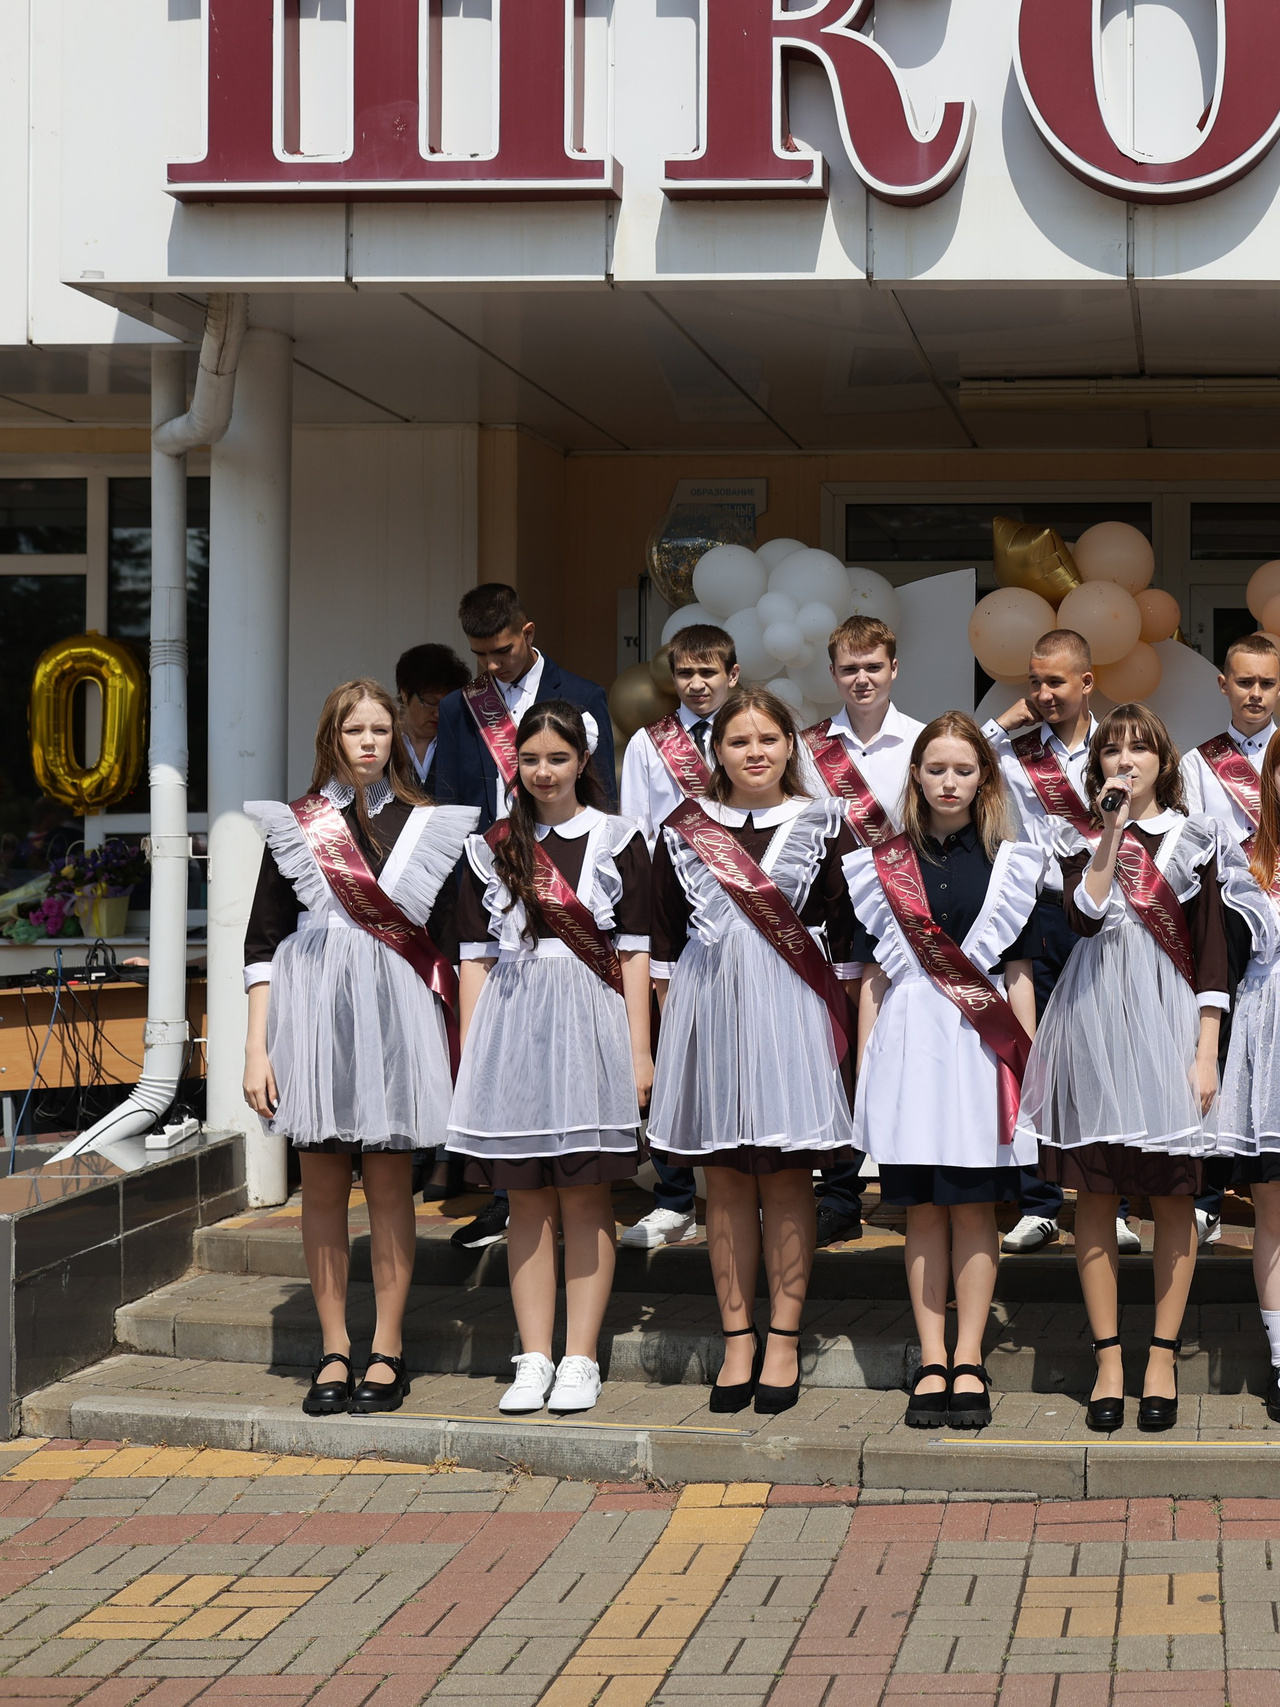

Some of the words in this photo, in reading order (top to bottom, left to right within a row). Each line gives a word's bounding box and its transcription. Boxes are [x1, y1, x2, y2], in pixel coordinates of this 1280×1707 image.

[690, 488, 755, 497] ОБРАЗОВАНИЕ
[692, 828, 782, 925] Выпускница
[775, 923, 810, 955] 2025
[953, 980, 998, 1011] 2025
